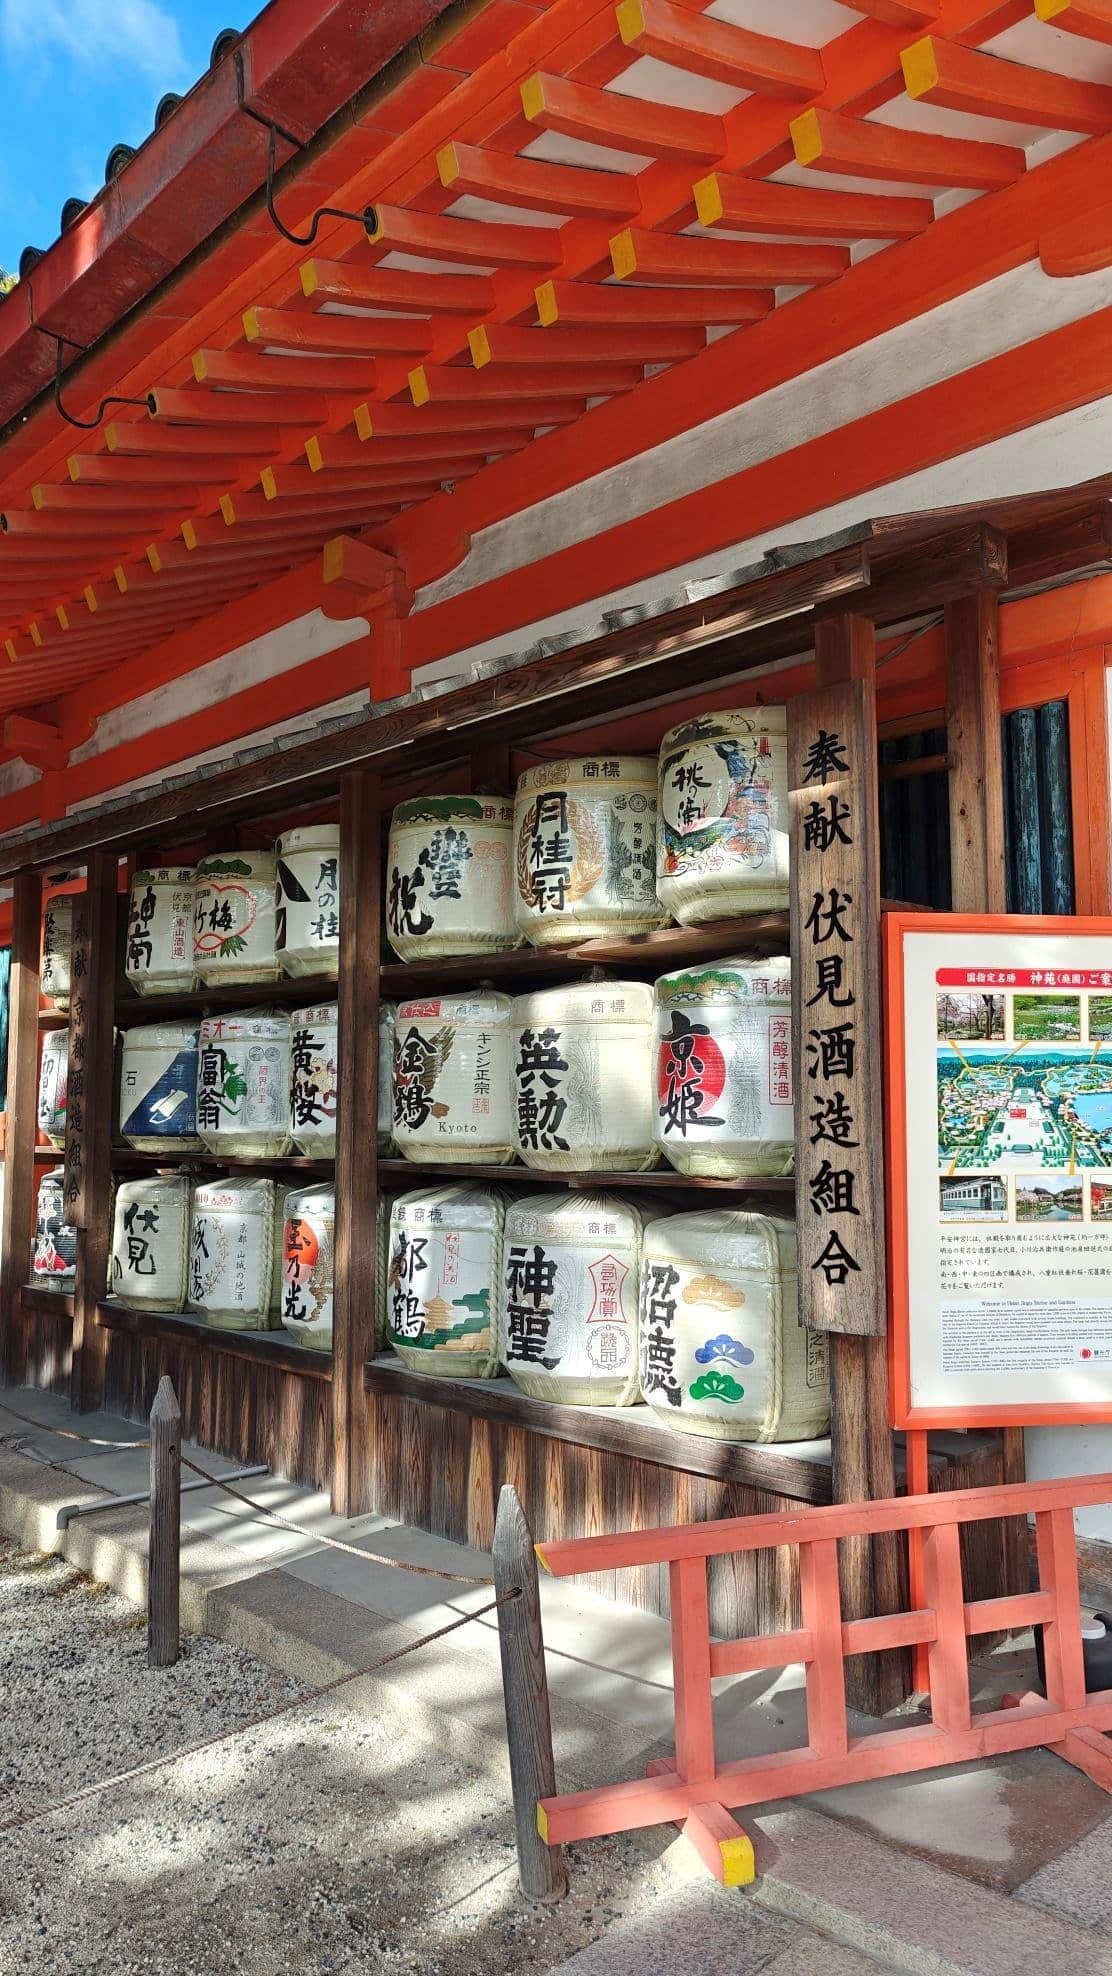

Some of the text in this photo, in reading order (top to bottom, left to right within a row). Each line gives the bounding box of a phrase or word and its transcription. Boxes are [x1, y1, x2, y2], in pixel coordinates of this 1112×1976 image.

[583, 761, 621, 778] 商標
[672, 761, 712, 827] 桃の滴
[482, 805, 513, 821] 商標
[530, 791, 573, 913] 月桂冠
[311, 858, 340, 940] 月の桂
[591, 999, 625, 1014] 商標
[751, 978, 792, 995] 商標
[802, 730, 862, 1286] 奉献 伏見酒造組合
[967, 972, 1017, 983] 国指定名勝
[199, 1042, 227, 1130] 富翁
[474, 1032, 492, 1094] キンシ正宗
[660, 1010, 726, 1137] 京姫
[772, 1021, 789, 1098] 芳醇清酒
[438, 1121, 477, 1134] Kyoto
[124, 1202, 159, 1275] 伏見
[414, 1207, 443, 1223] 商標
[588, 1222, 617, 1235] 商標
[393, 1231, 428, 1342] 都鶴
[506, 1245, 563, 1371] 神聖
